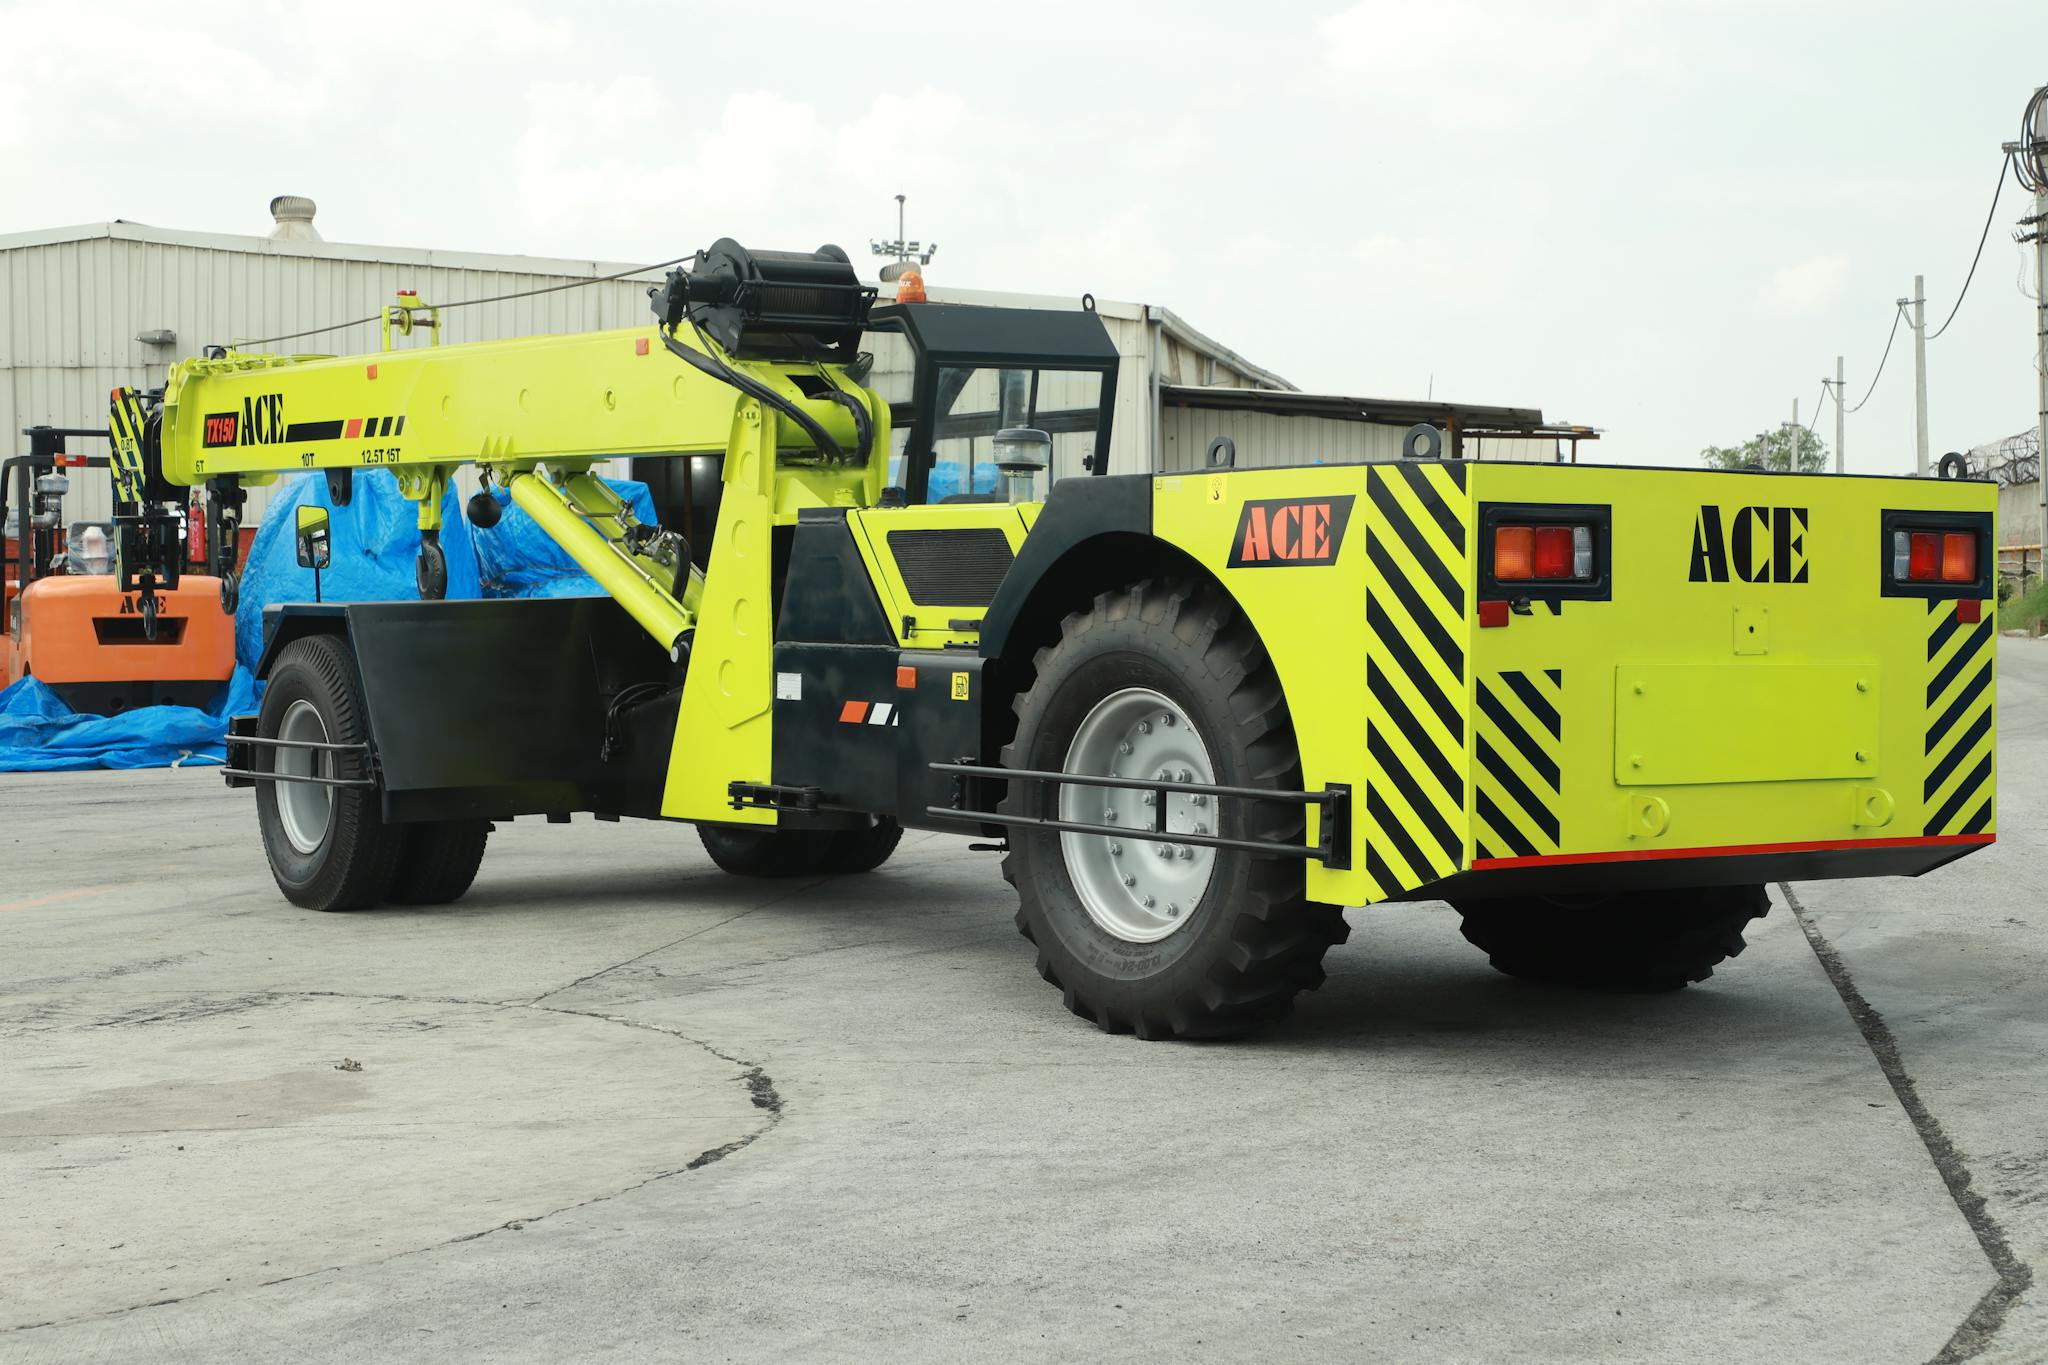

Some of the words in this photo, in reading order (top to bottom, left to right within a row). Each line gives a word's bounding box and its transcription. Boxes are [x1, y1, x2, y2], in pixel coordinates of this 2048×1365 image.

[207, 417, 235, 443] TX150
[241, 394, 284, 446] ACE
[121, 438, 133, 451] 0.8T
[302, 453, 315, 467] 10T
[362, 449, 384, 463] 12.5T
[387, 448, 401, 463] 15T
[195, 460, 204, 472] 6T
[1241, 504, 1330, 561] ACE
[1688, 505, 1808, 583] ACE
